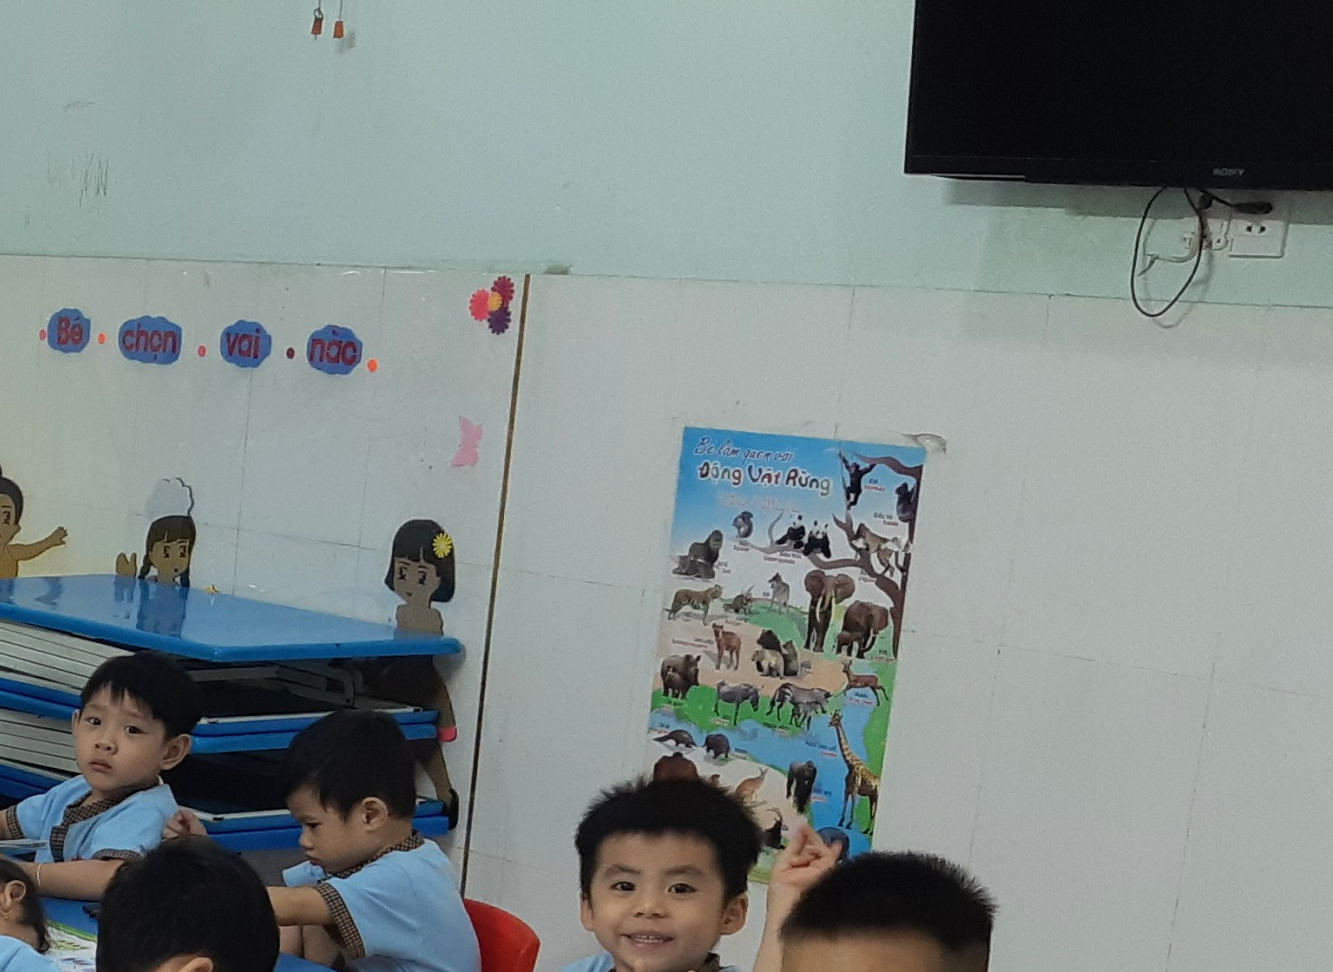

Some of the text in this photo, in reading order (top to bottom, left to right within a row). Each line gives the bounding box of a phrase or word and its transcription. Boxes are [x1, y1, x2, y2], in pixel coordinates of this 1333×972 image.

[57, 315, 84, 346] Bé
[122, 322, 178, 360] chọn
[225, 328, 261, 360] vai
